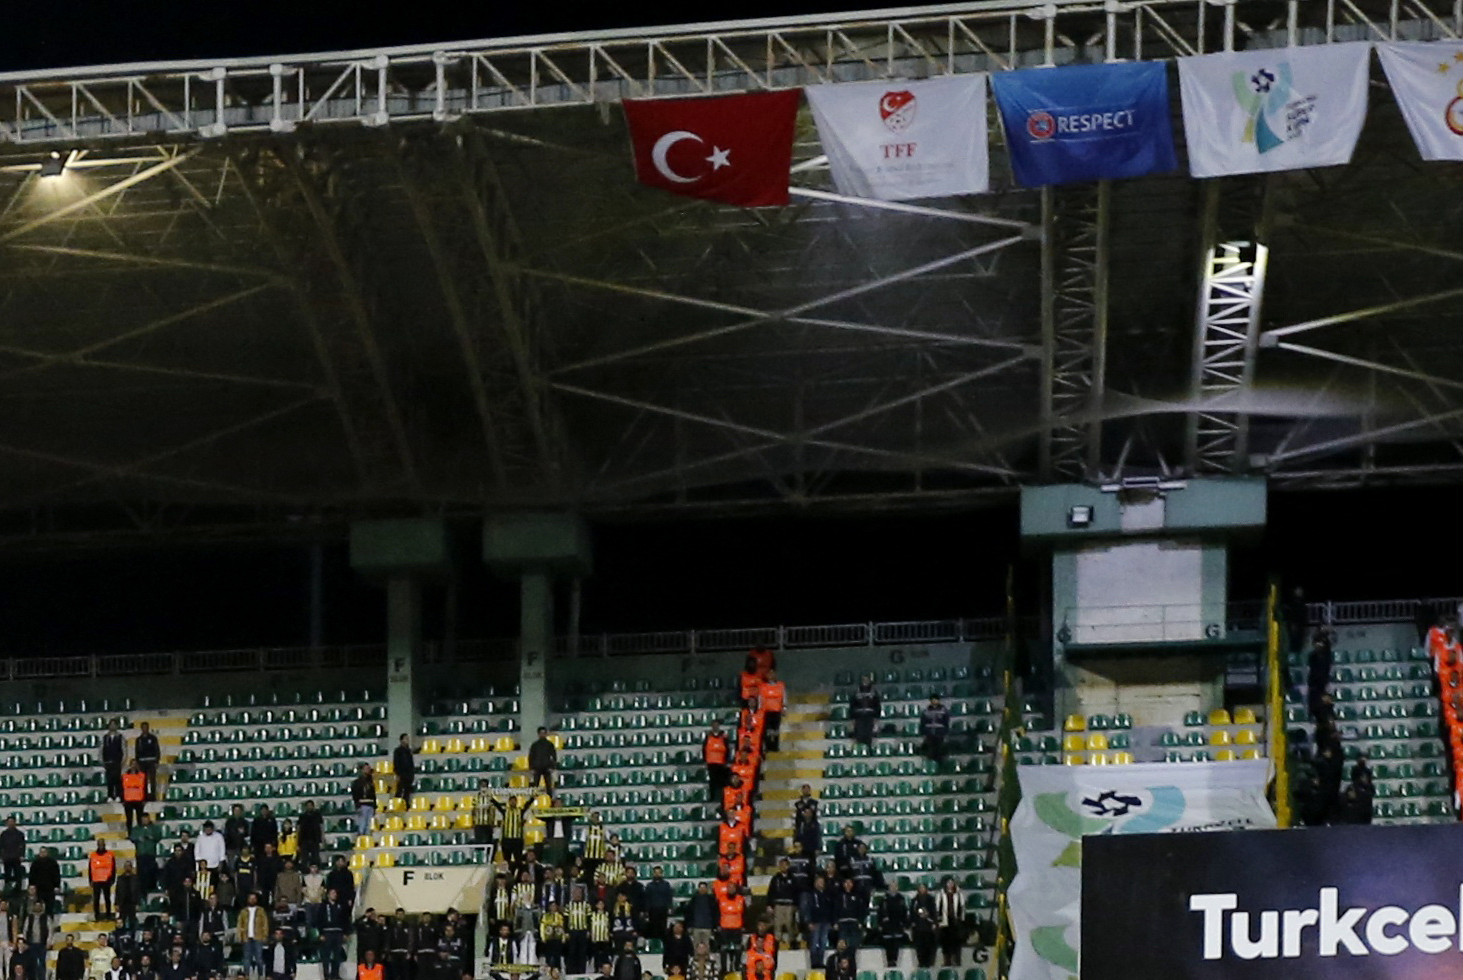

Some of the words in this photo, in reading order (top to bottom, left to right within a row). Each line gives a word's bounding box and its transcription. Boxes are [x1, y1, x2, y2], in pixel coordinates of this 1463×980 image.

[1057, 108, 1135, 133] RESPECT
[879, 142, 918, 159] TFF
[403, 871, 415, 886] F
[1189, 883, 1463, 960] Turkce
